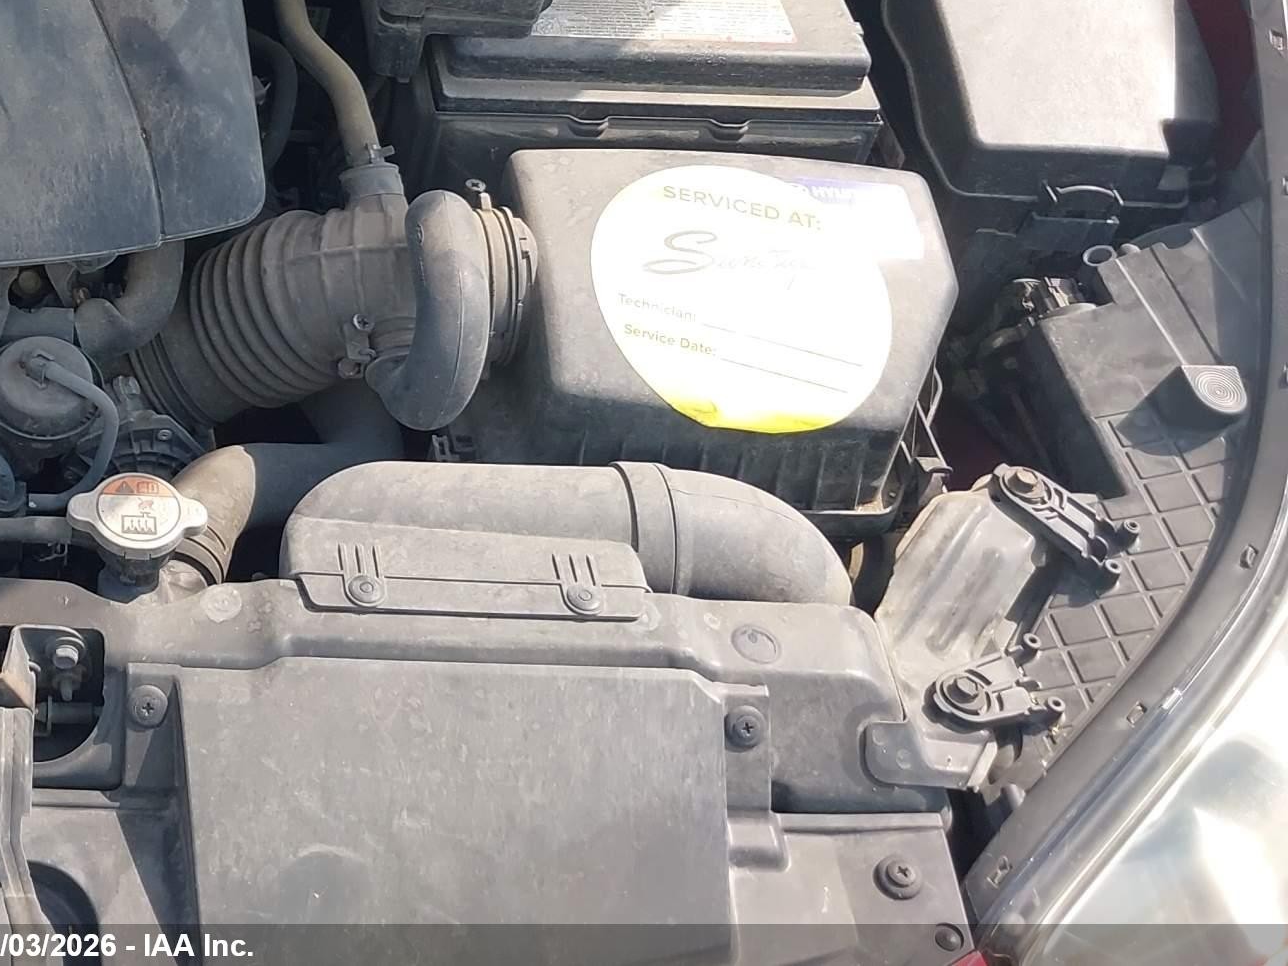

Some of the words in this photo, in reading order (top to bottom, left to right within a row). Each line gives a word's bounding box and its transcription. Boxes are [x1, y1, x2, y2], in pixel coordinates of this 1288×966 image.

[663, 184, 781, 221] SERVICED
[788, 210, 822, 231] AT:
[617, 292, 697, 322] Technician:
[624, 323, 676, 346] Service
[679, 337, 717, 357] Date:
